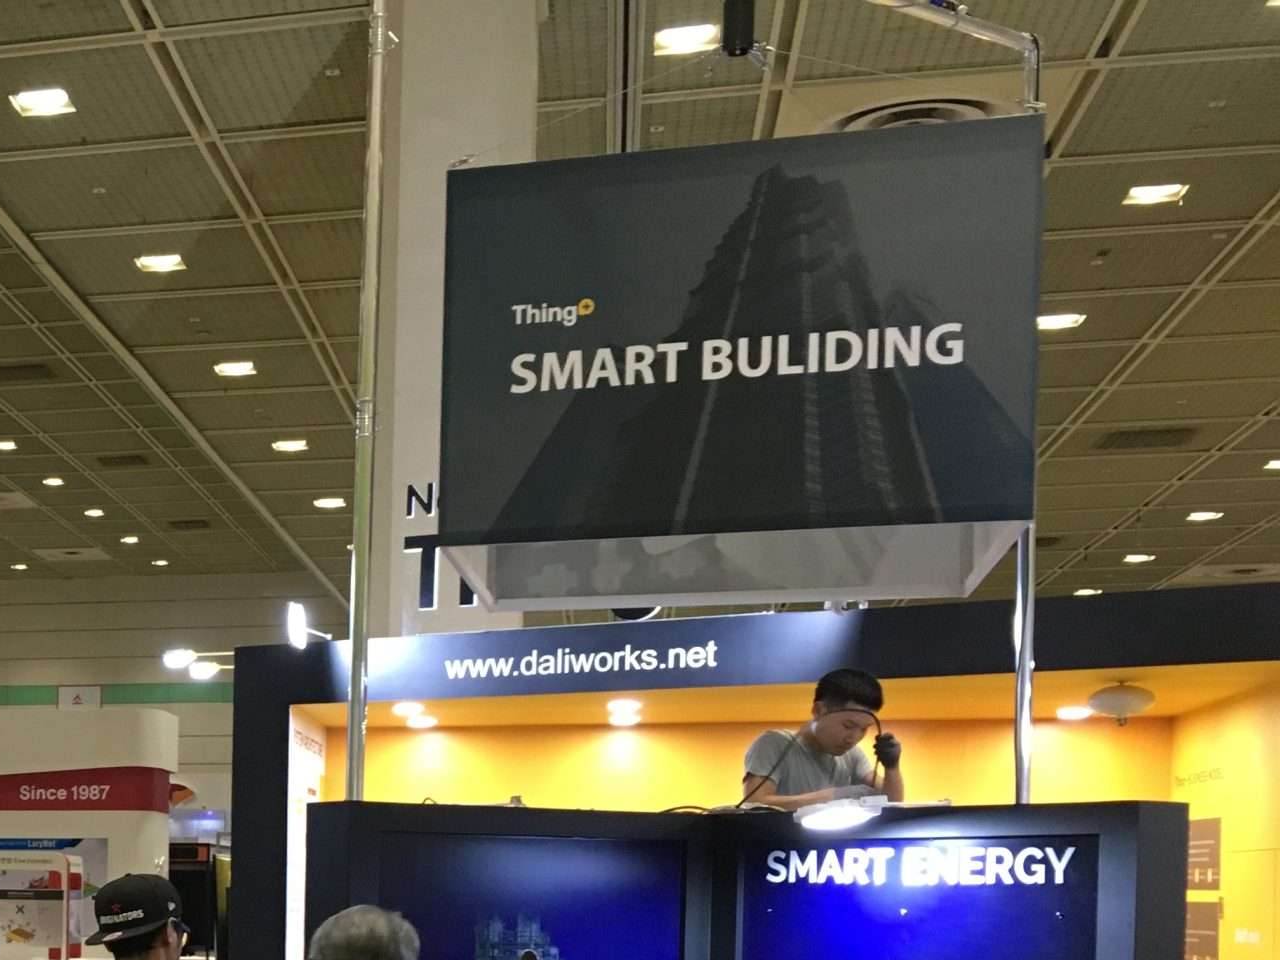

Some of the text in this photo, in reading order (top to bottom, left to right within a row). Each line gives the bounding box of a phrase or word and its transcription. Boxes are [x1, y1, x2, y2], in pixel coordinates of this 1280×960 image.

[510, 323, 964, 394] SMART BULIDING
[445, 640, 718, 680] www.daliworks.net
[20, 785, 110, 801] Since 1987
[766, 846, 1076, 886] SMART ENERGY
